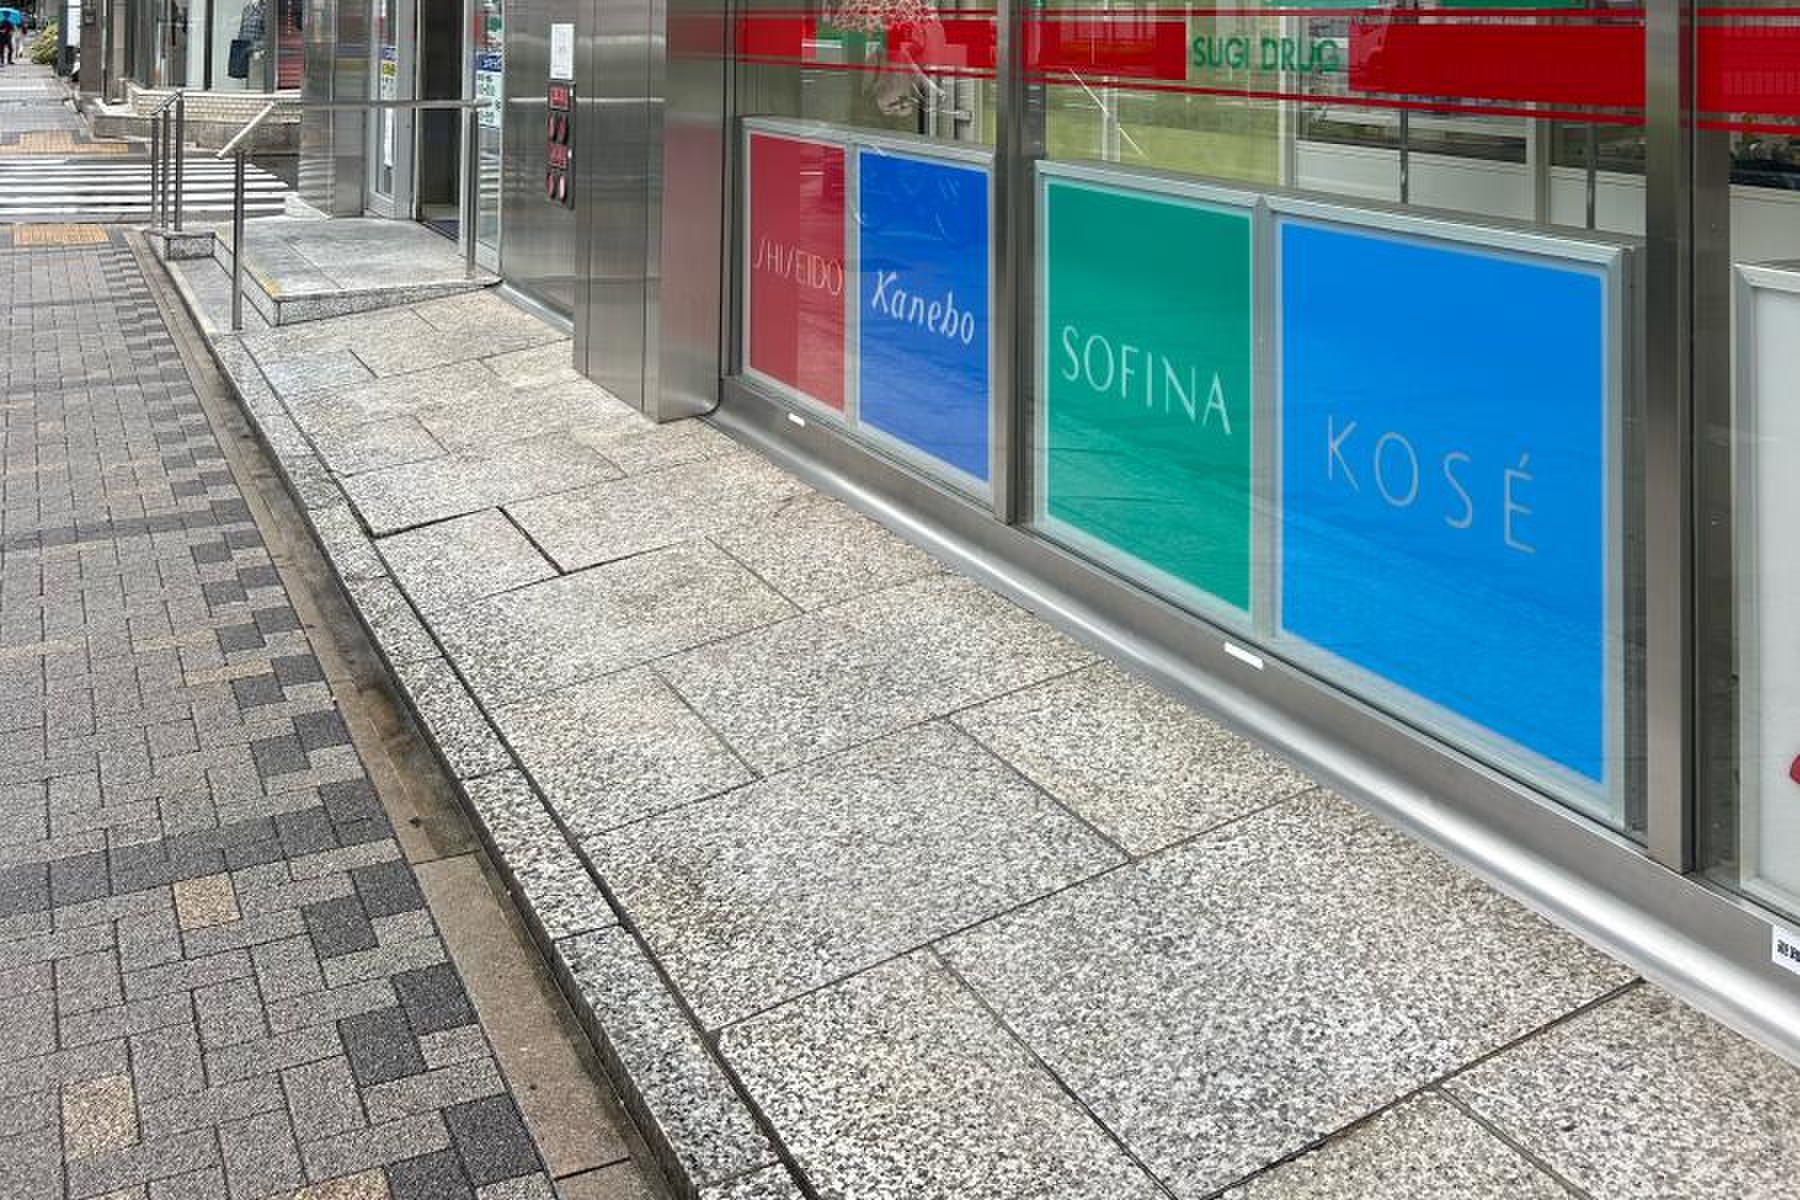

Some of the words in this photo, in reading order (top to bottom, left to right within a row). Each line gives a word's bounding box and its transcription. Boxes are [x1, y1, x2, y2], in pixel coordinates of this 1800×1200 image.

[1191, 35, 1249, 69] SUGI
[1261, 36, 1341, 73] DRUG
[752, 233, 844, 297] SHISEIDO
[871, 270, 975, 346] Kanebo
[1061, 324, 1232, 437] SOFINA
[1327, 413, 1537, 556] KOSÉ
